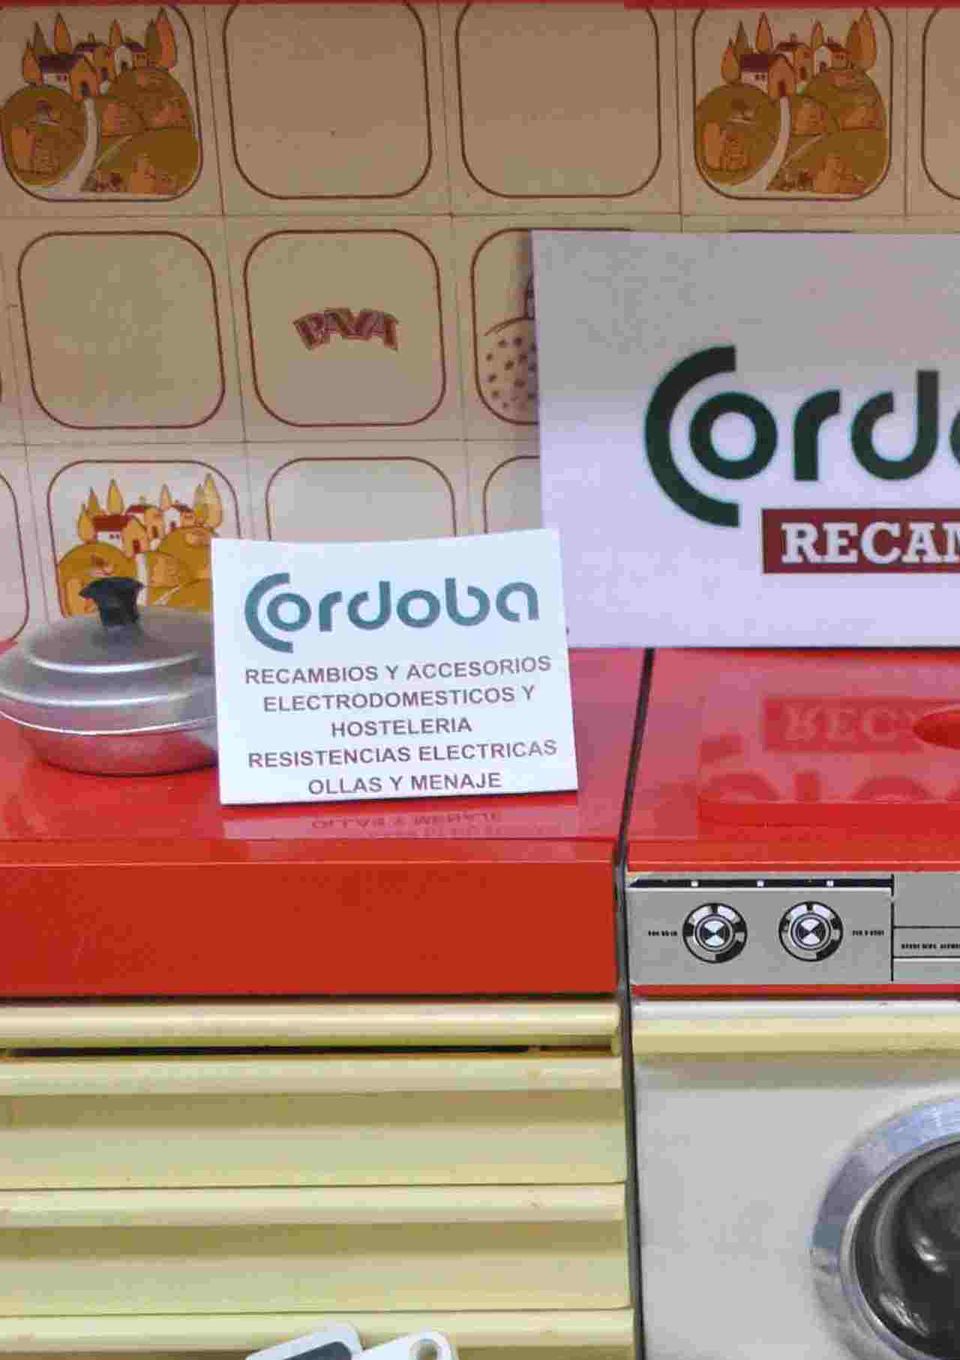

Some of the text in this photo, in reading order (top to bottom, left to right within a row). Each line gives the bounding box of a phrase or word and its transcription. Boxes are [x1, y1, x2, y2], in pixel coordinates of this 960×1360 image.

[244, 572, 540, 654] Cordoba
[245, 655, 552, 685] RECAMBIOS Y ACCESORIOS
[263, 683, 535, 713] ELECTRODOMESTICOS Y
[331, 716, 473, 739] HOSTELERIA
[248, 739, 558, 769] RESISTENCIAS ELECTRICAS
[308, 772, 503, 796] OLLAS Y MENAJE
